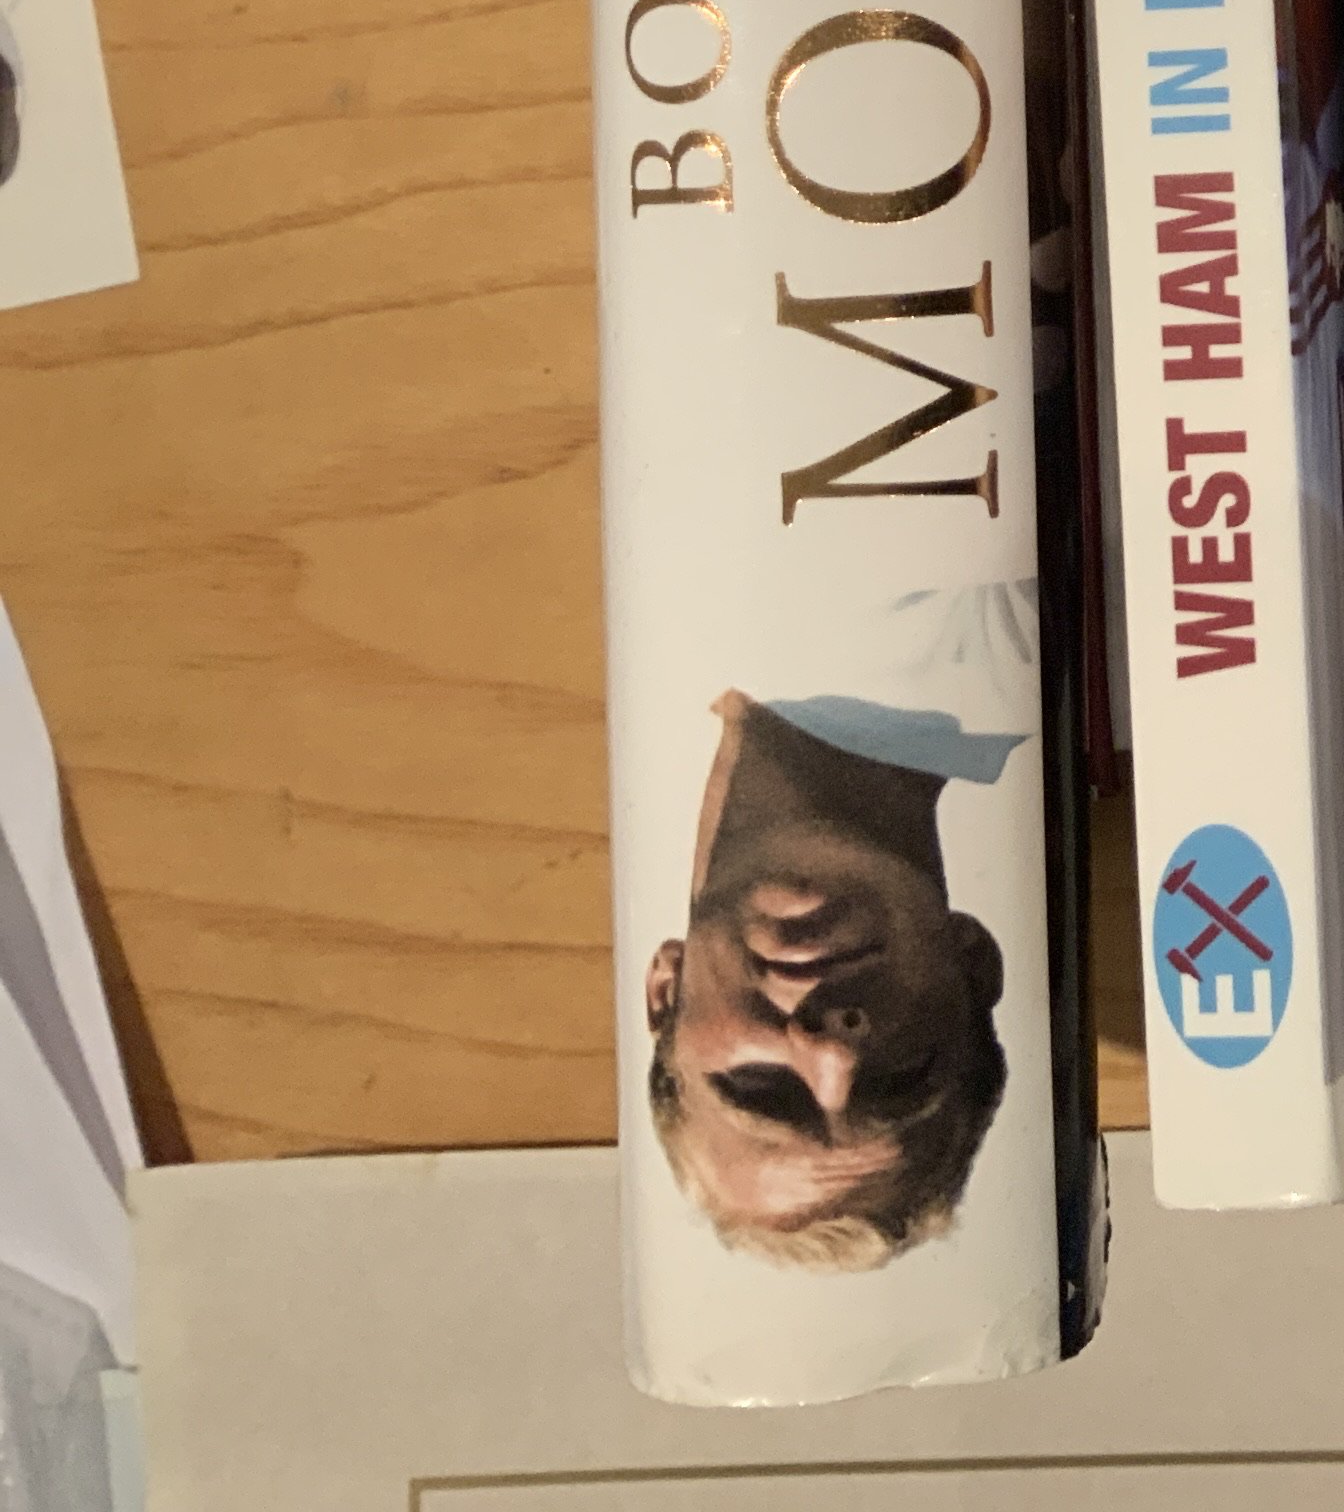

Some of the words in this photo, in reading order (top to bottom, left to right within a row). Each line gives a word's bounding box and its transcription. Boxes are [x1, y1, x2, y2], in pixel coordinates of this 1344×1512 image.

[1148, 47, 1231, 136] IN
[1153, 171, 1244, 382] HAM
[1165, 417, 1257, 679] WEST
